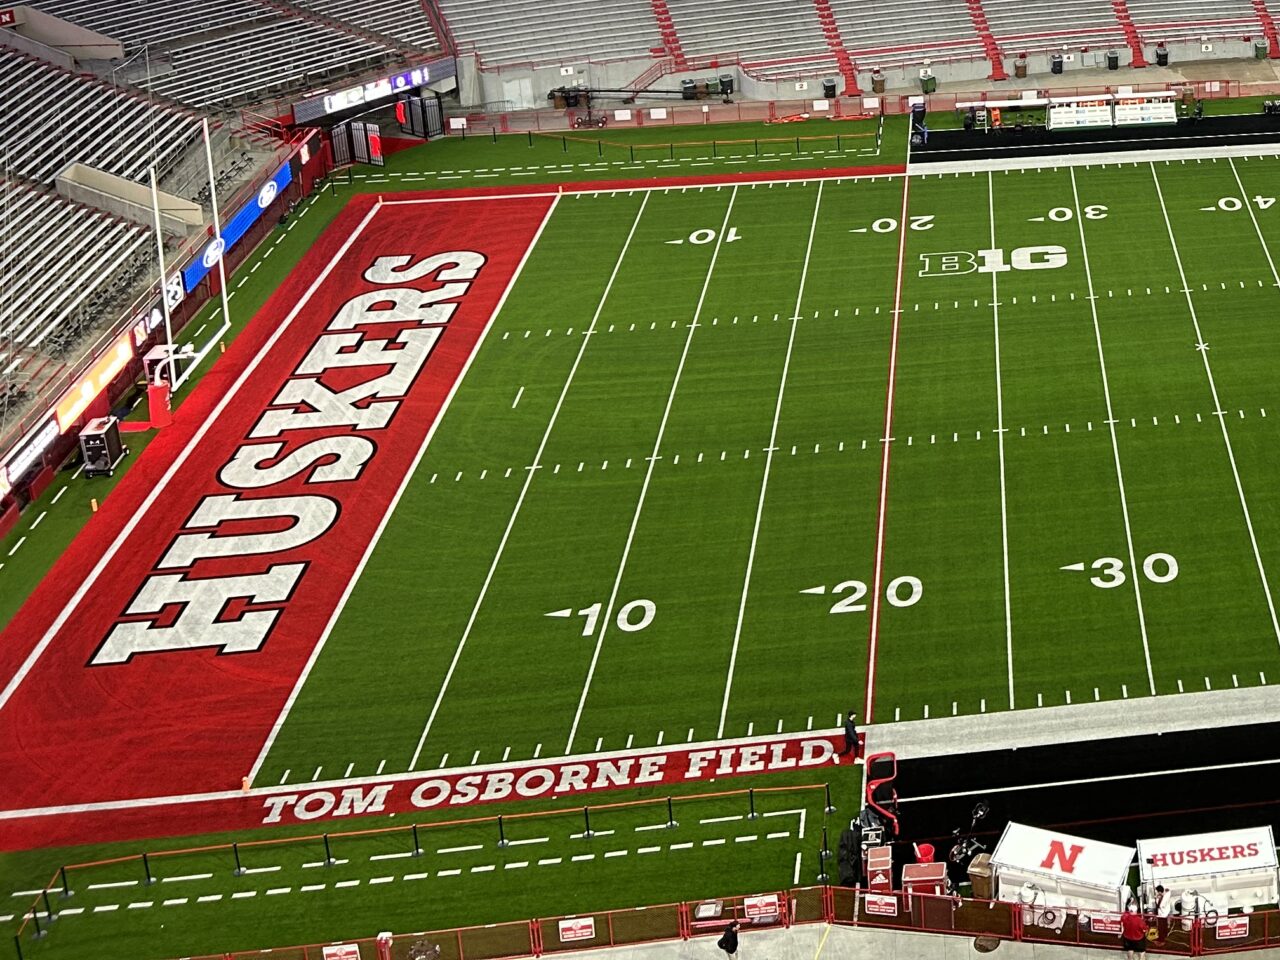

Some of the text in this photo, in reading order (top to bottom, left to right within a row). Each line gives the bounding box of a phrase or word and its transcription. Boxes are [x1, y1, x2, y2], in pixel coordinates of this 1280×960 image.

[1, 14, 10, 22] N
[1048, 204, 1108, 222] 30
[1219, 195, 1276, 212] 40
[689, 226, 741, 245] 10
[871, 215, 936, 234] 20
[90, 251, 487, 665] HUSKERS
[1090, 552, 1180, 588] 30
[828, 576, 923, 614] 20
[577, 598, 657, 637] 10
[262, 739, 836, 824] TOM OSBORNE FIELD
[1040, 839, 1083, 874] N
[1151, 842, 1259, 868] HUSKERS
